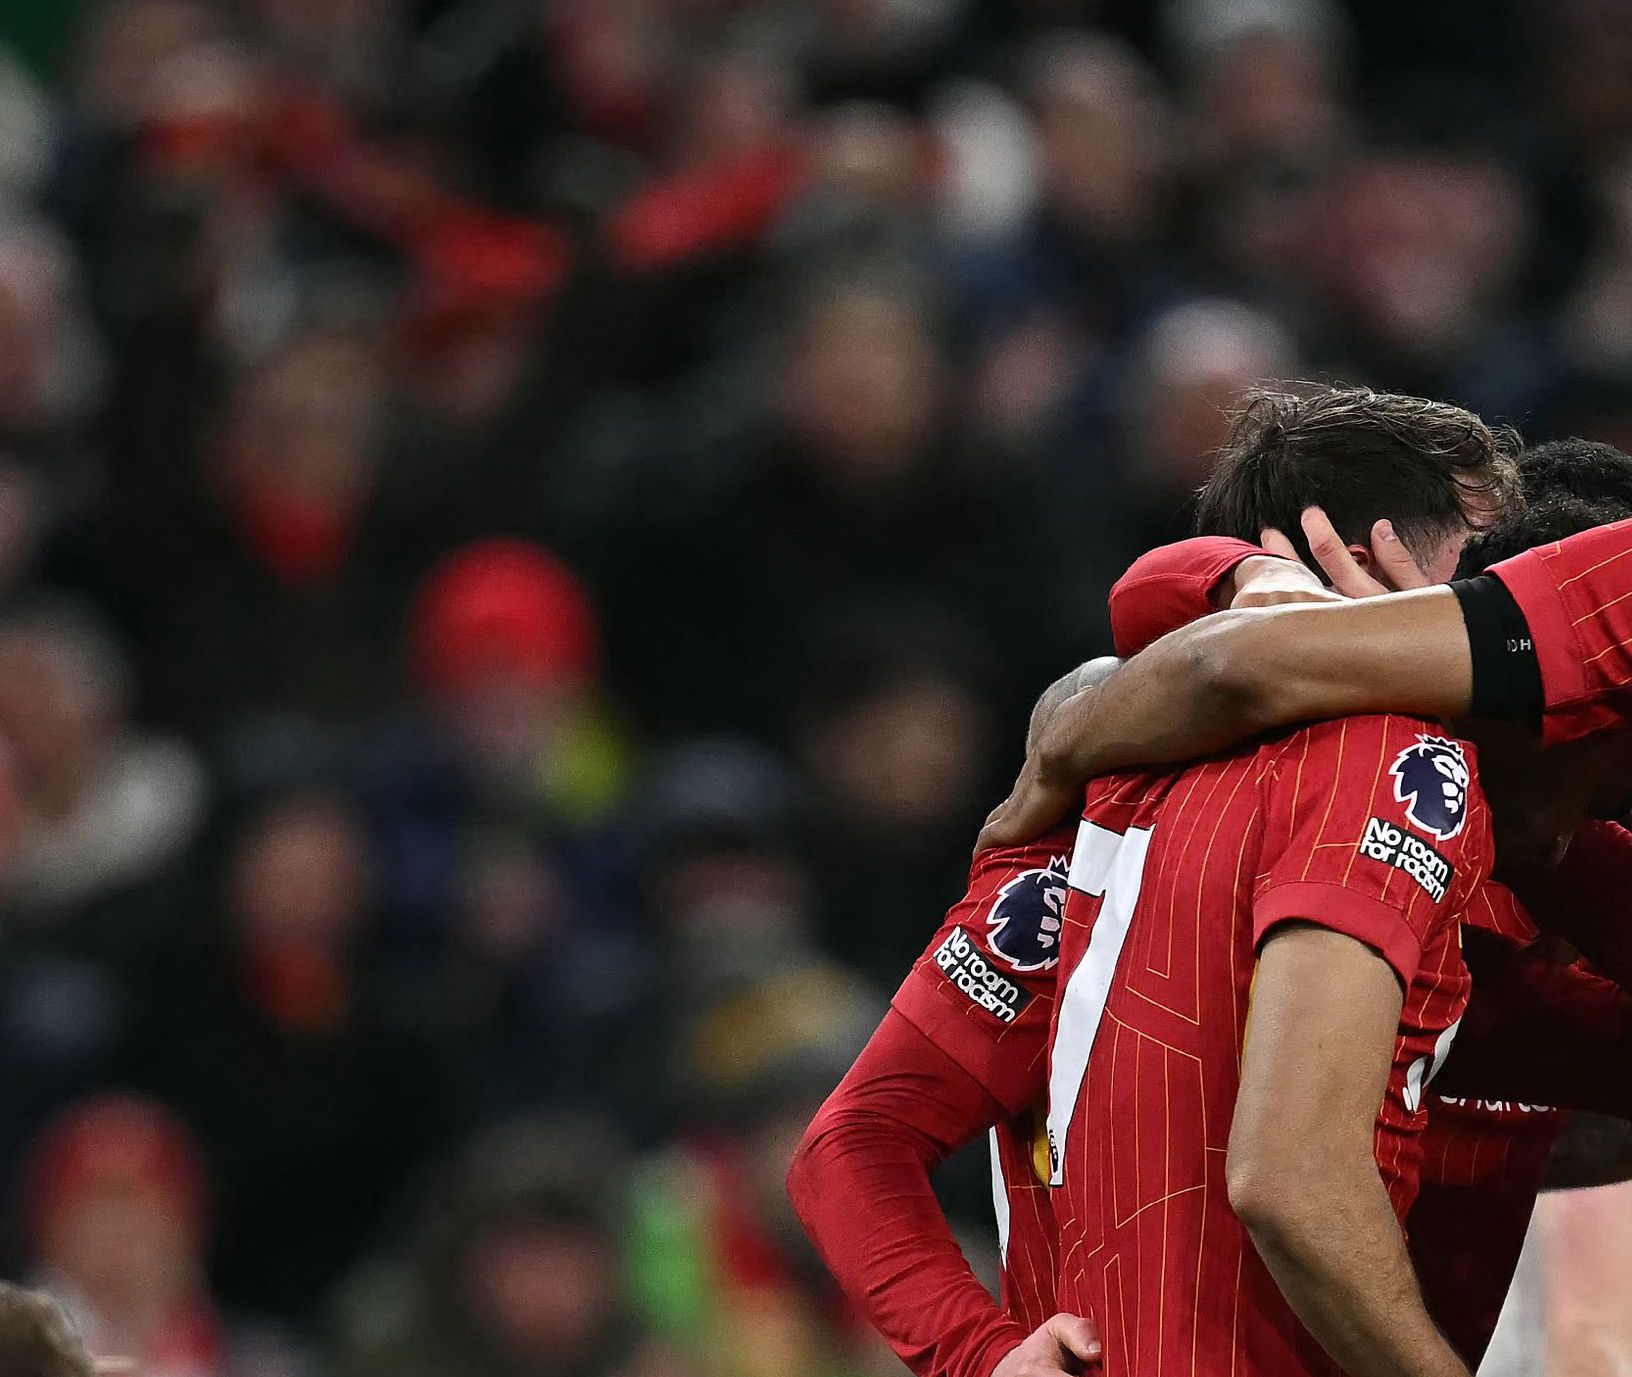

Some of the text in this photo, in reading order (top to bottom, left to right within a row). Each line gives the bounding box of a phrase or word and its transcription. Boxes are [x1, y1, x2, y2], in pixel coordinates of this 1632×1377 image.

[1359, 835, 1446, 904] for racism
[1366, 817, 1449, 883] No room
[944, 925, 1019, 1004] No room
[949, 965, 1016, 1023] racism
[1046, 819, 1157, 1187] 7
